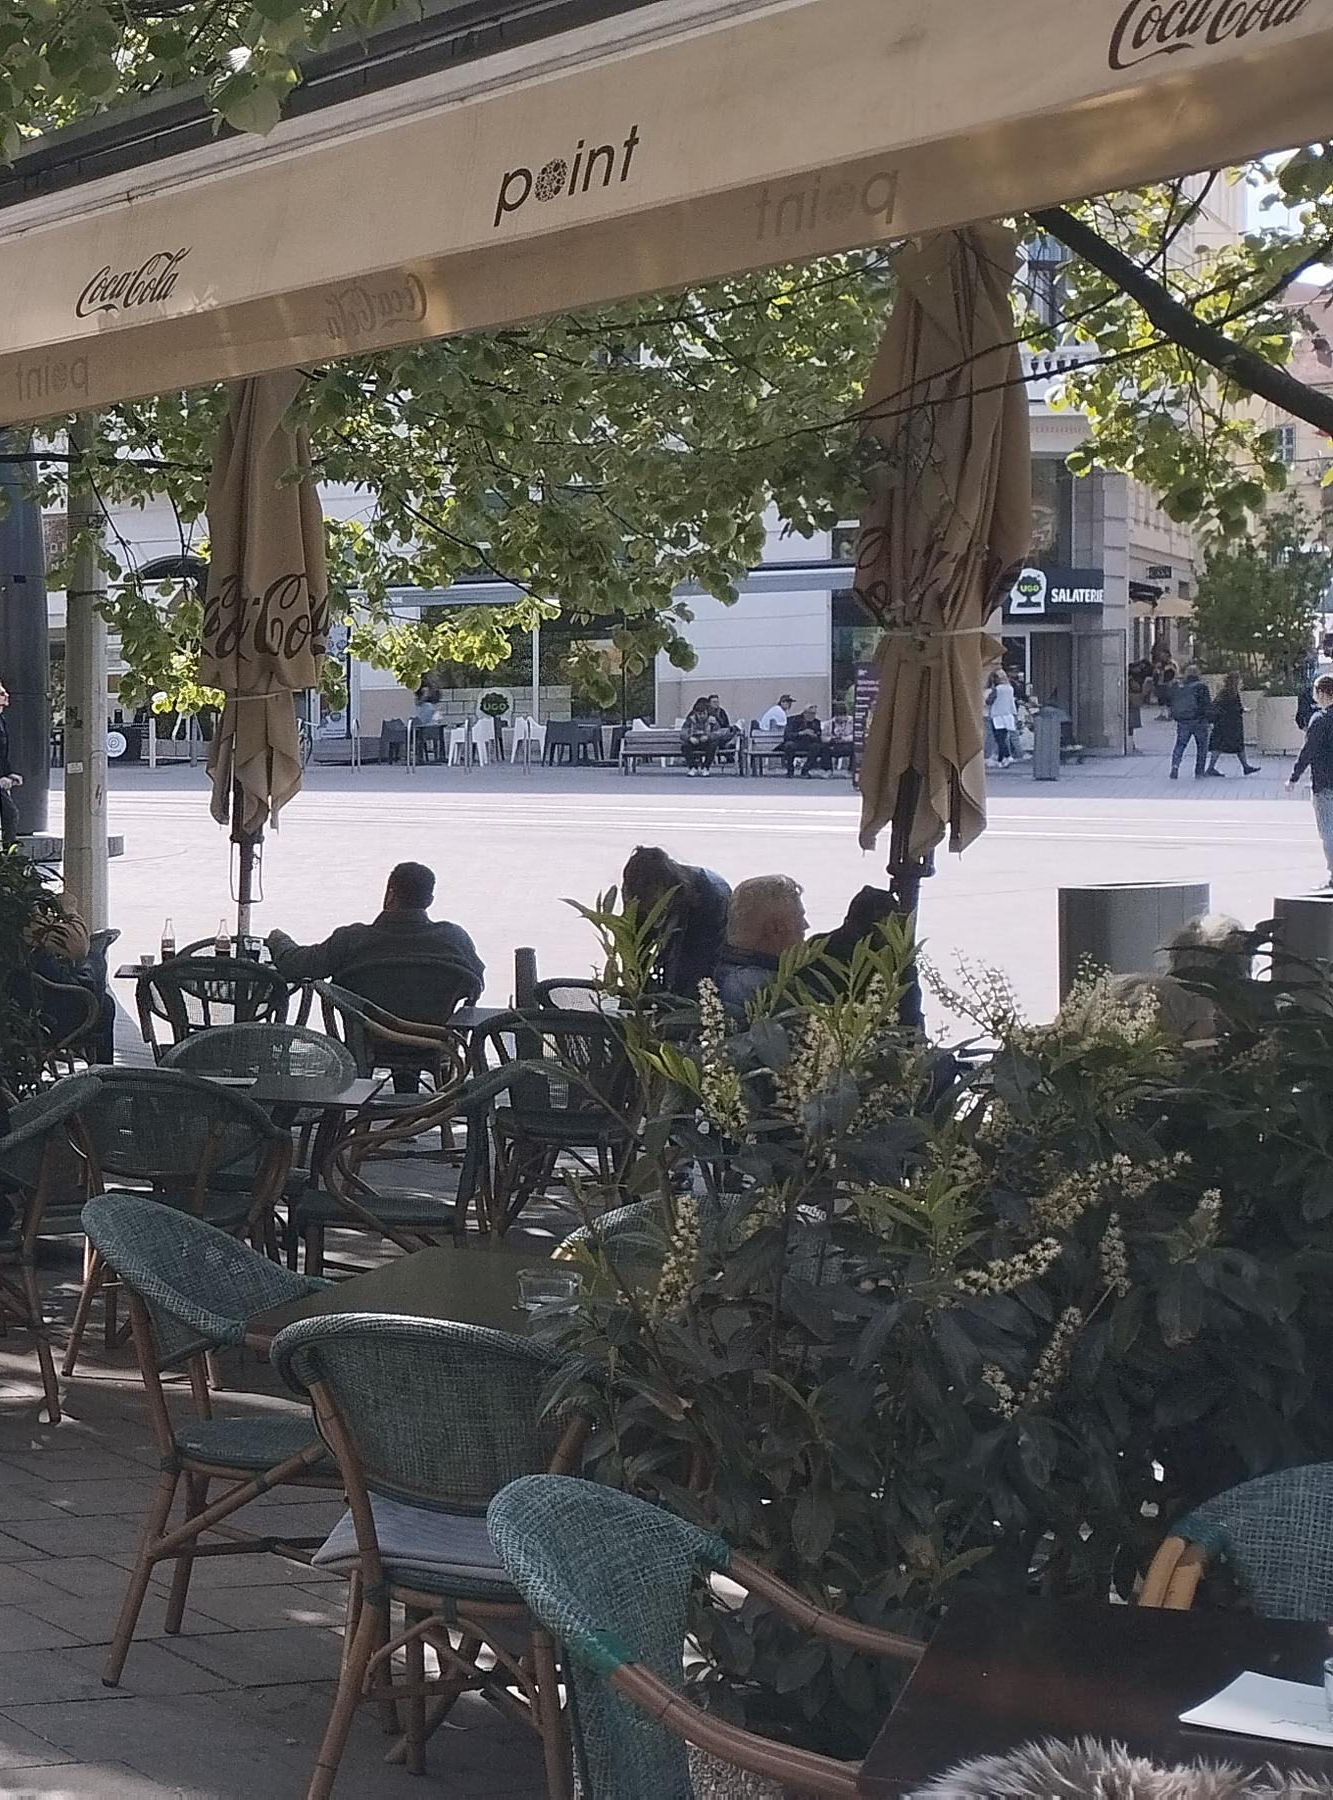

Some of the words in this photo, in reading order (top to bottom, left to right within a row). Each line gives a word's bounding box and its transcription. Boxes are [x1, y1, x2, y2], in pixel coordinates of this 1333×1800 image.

[494, 124, 640, 227] point
[1019, 584, 1040, 593] UGO
[1051, 588, 1104, 603] SALATERIE
